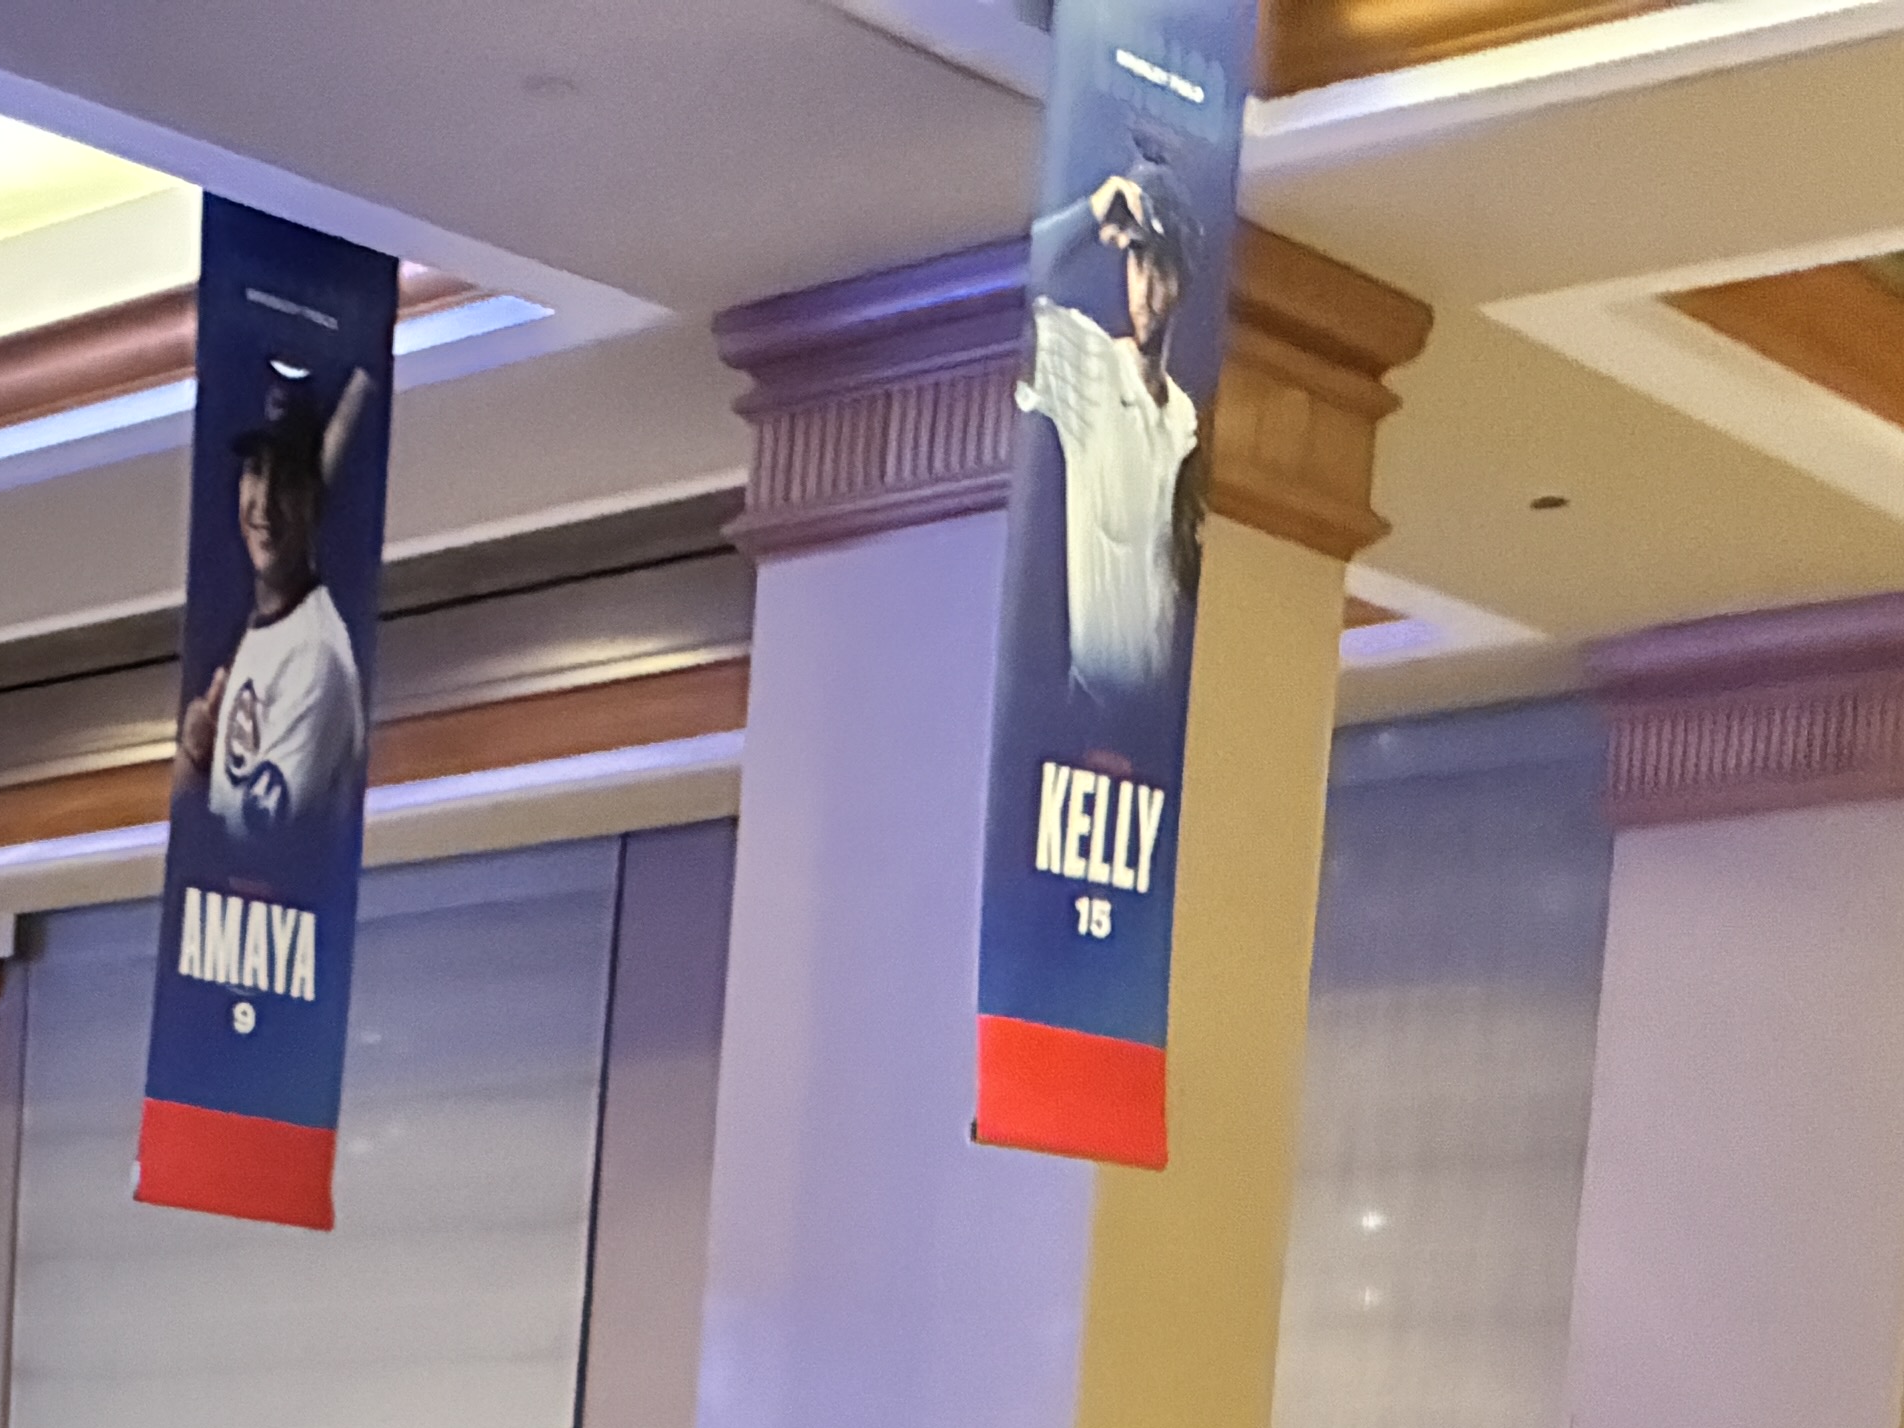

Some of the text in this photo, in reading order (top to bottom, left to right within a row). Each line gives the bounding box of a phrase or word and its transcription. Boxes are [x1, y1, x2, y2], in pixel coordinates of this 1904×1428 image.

[1036, 761, 1165, 894] KELLY
[178, 886, 316, 1001] AMAYA
[1074, 896, 1112, 939] 15
[233, 1001, 256, 1034] 9
